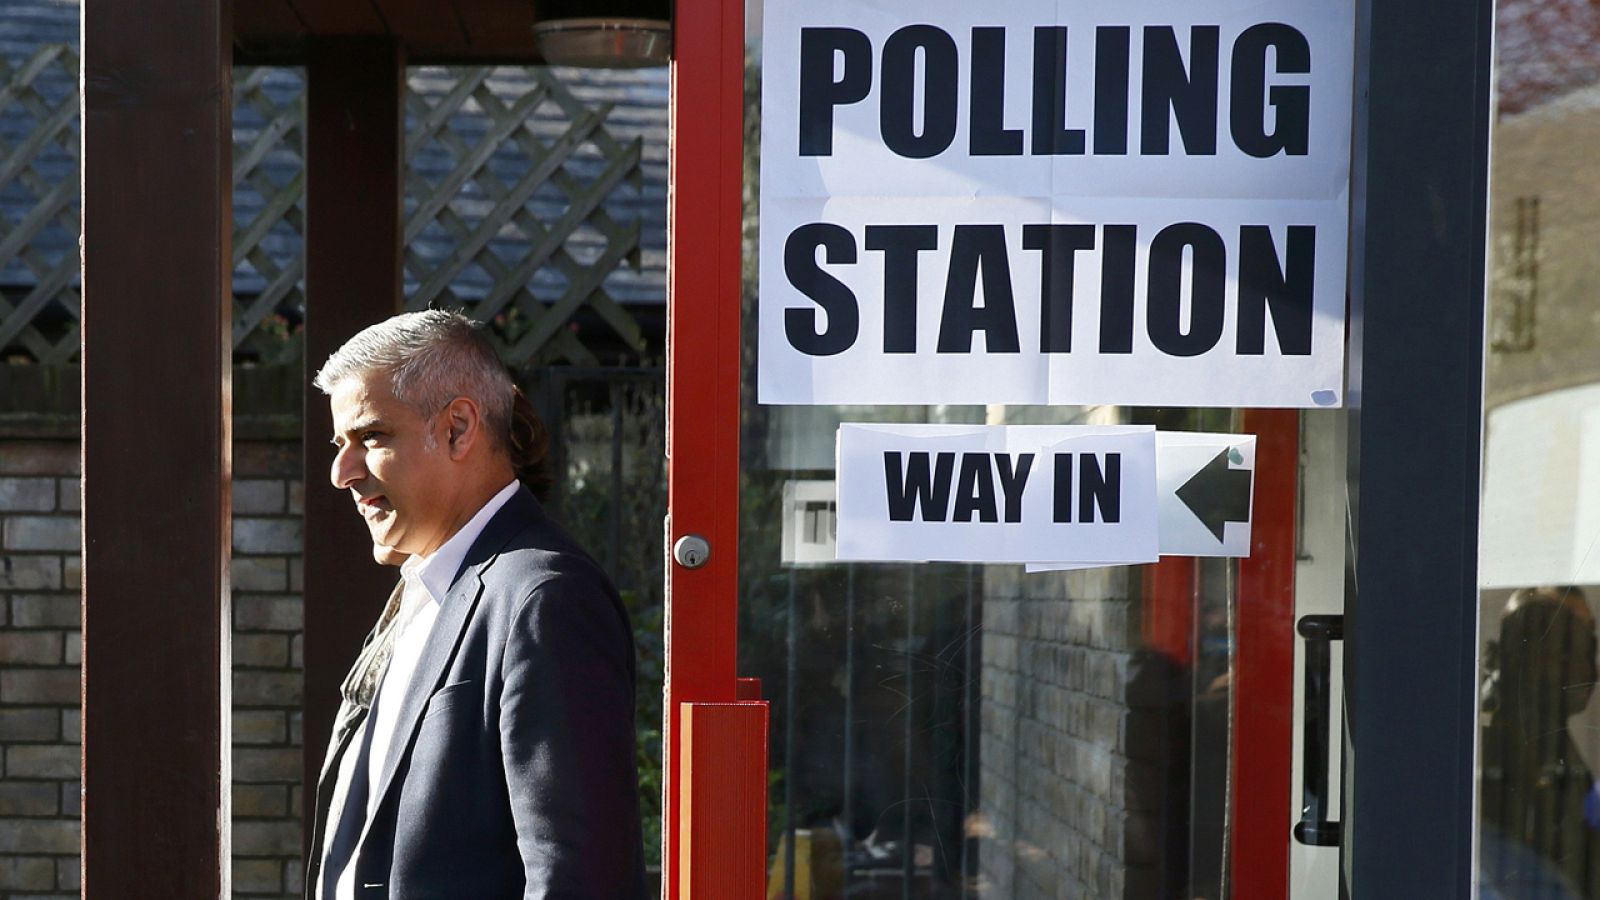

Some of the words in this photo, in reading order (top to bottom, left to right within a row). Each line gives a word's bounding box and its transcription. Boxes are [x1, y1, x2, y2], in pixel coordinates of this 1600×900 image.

[799, 23, 1310, 158] POLLING
[785, 223, 1316, 356] STATION
[884, 452, 1035, 523] WAY
[1053, 453, 1120, 523] IN
